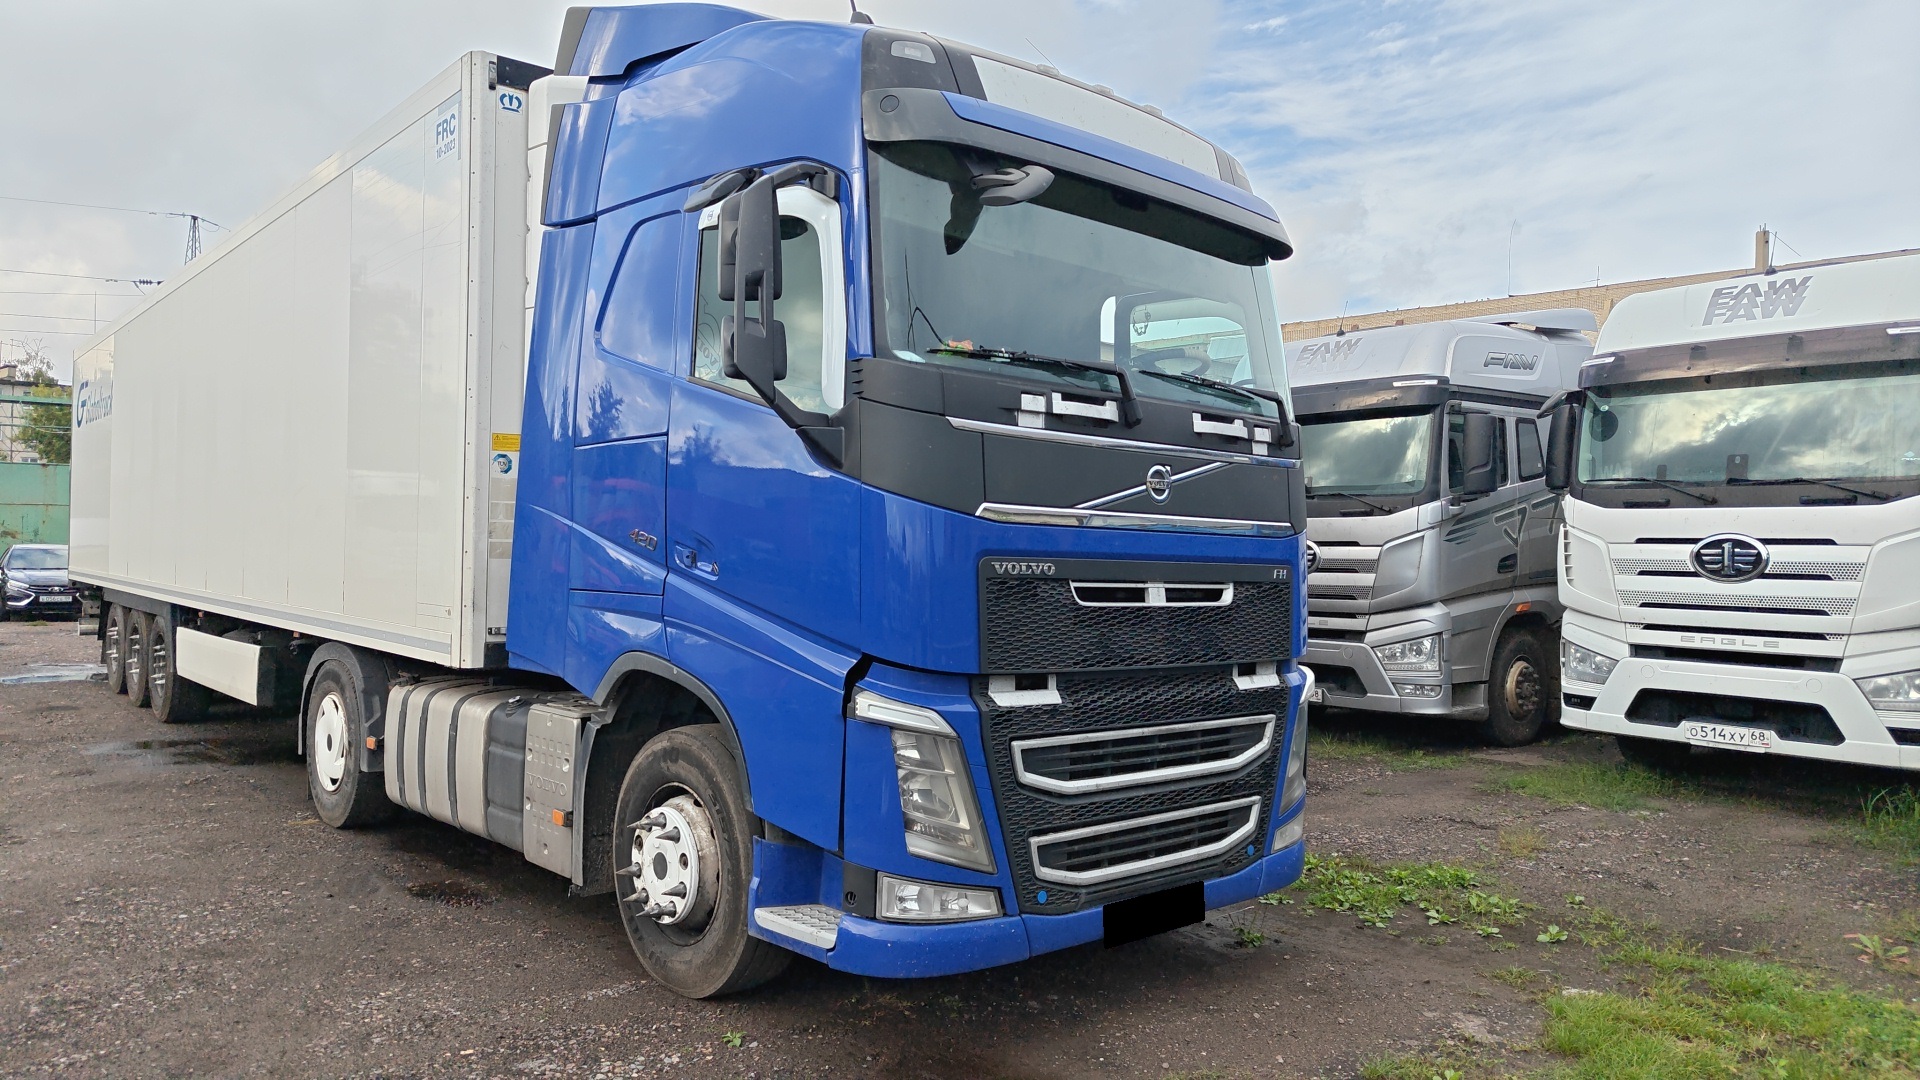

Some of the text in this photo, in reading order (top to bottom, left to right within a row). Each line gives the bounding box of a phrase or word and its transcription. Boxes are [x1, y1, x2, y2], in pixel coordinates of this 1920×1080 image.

[435, 113, 456, 145] FRC
[435, 138, 456, 159] 10-2023
[1483, 351, 1539, 371] FAW
[629, 528, 657, 551] 420
[991, 561, 1056, 576] VOLVO
[1273, 568, 1287, 579] FH
[1680, 635, 1780, 649] EAGLE
[1750, 730, 1766, 741] 68
[526, 771, 568, 797] VOLVO
